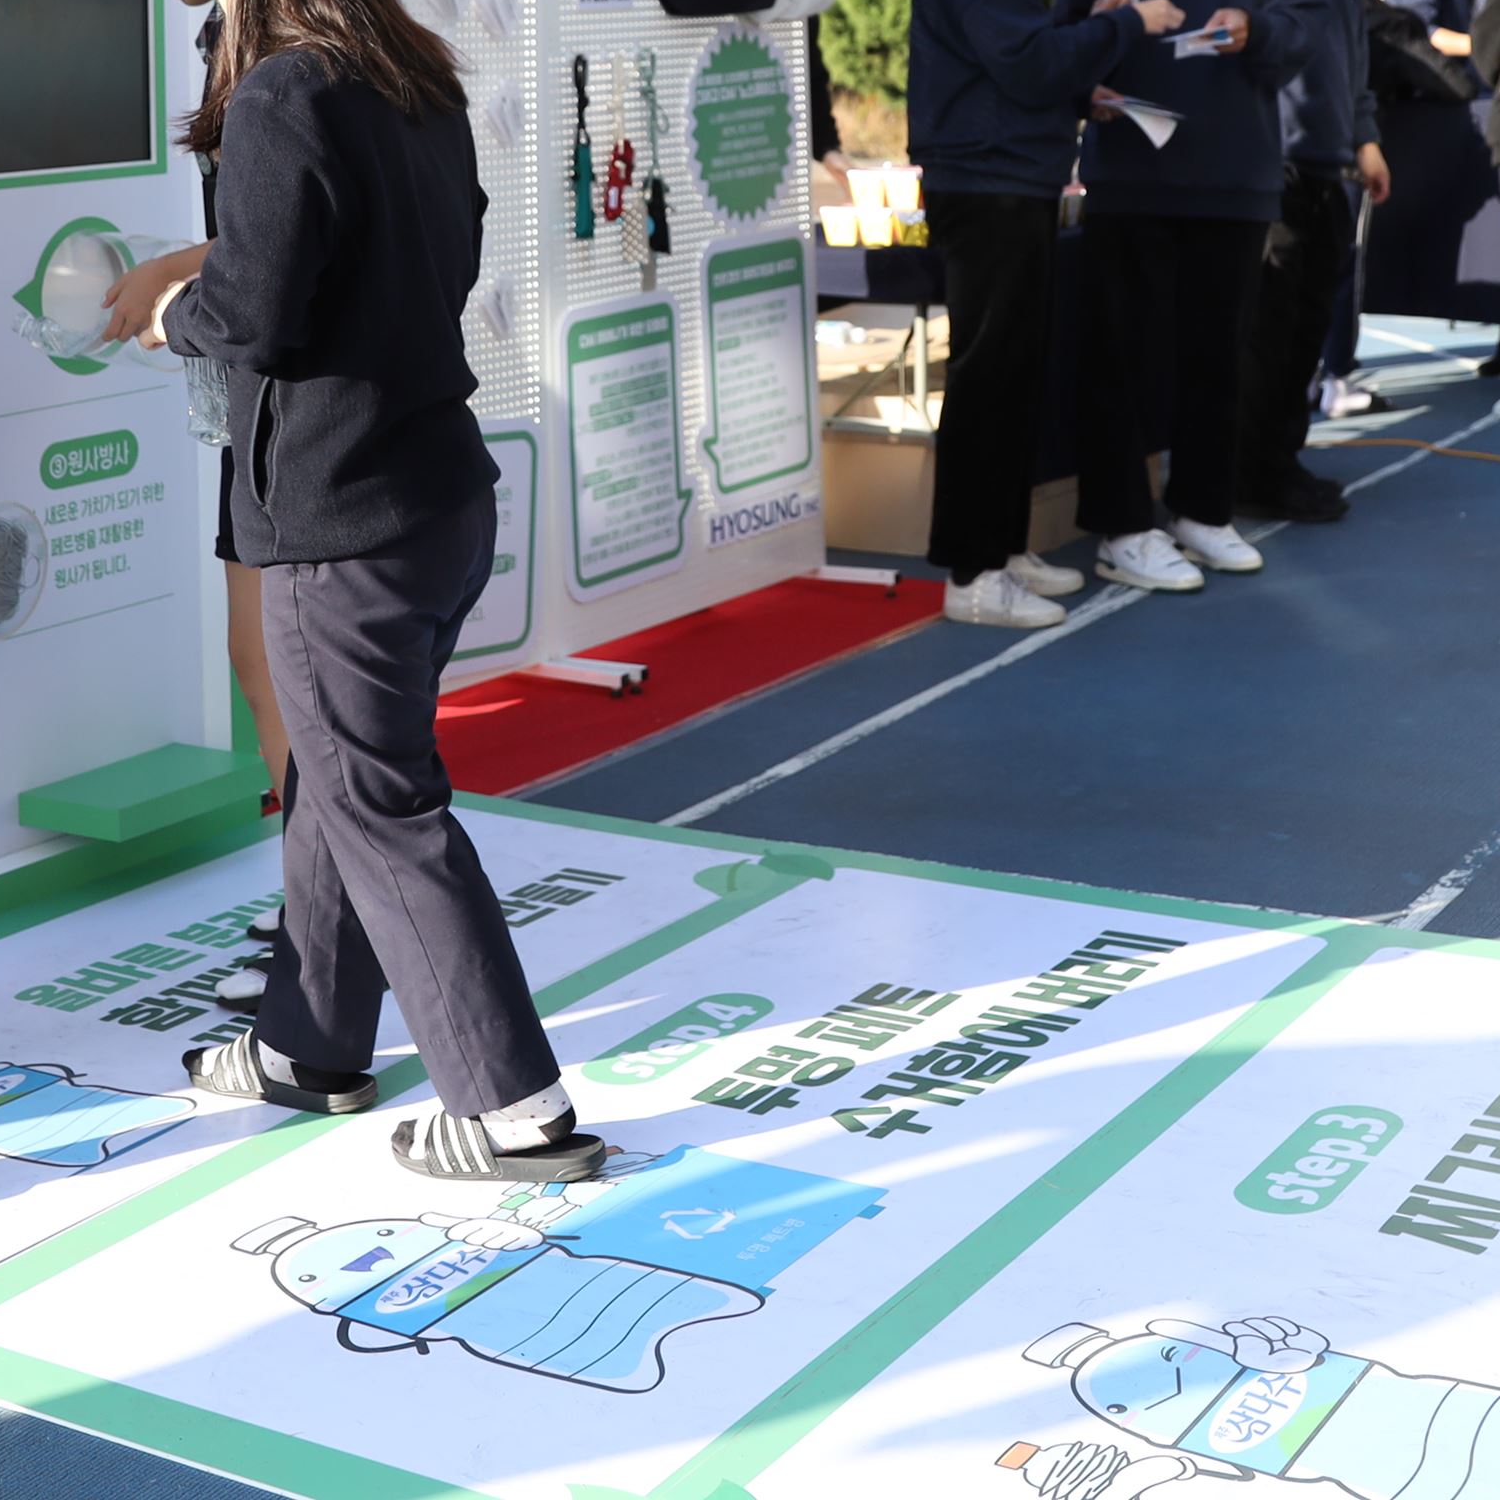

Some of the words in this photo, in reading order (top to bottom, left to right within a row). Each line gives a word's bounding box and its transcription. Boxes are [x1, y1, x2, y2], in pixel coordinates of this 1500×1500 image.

[710, 492, 801, 544] HYOSUNG
[92, 553, 131, 580] 됩니다.
[14, 942, 208, 1013] 올바른
[611, 1000, 759, 1079] step.4
[690, 1044, 856, 1116] 투명
[794, 981, 962, 1052] 페트
[830, 1004, 1083, 1140] 수거함에
[1011, 929, 1189, 1011] 버리기
[1264, 1113, 1387, 1206] step.3
[391, 1247, 489, 1307] 삼다수
[1225, 1372, 1302, 1443] 삼다수
